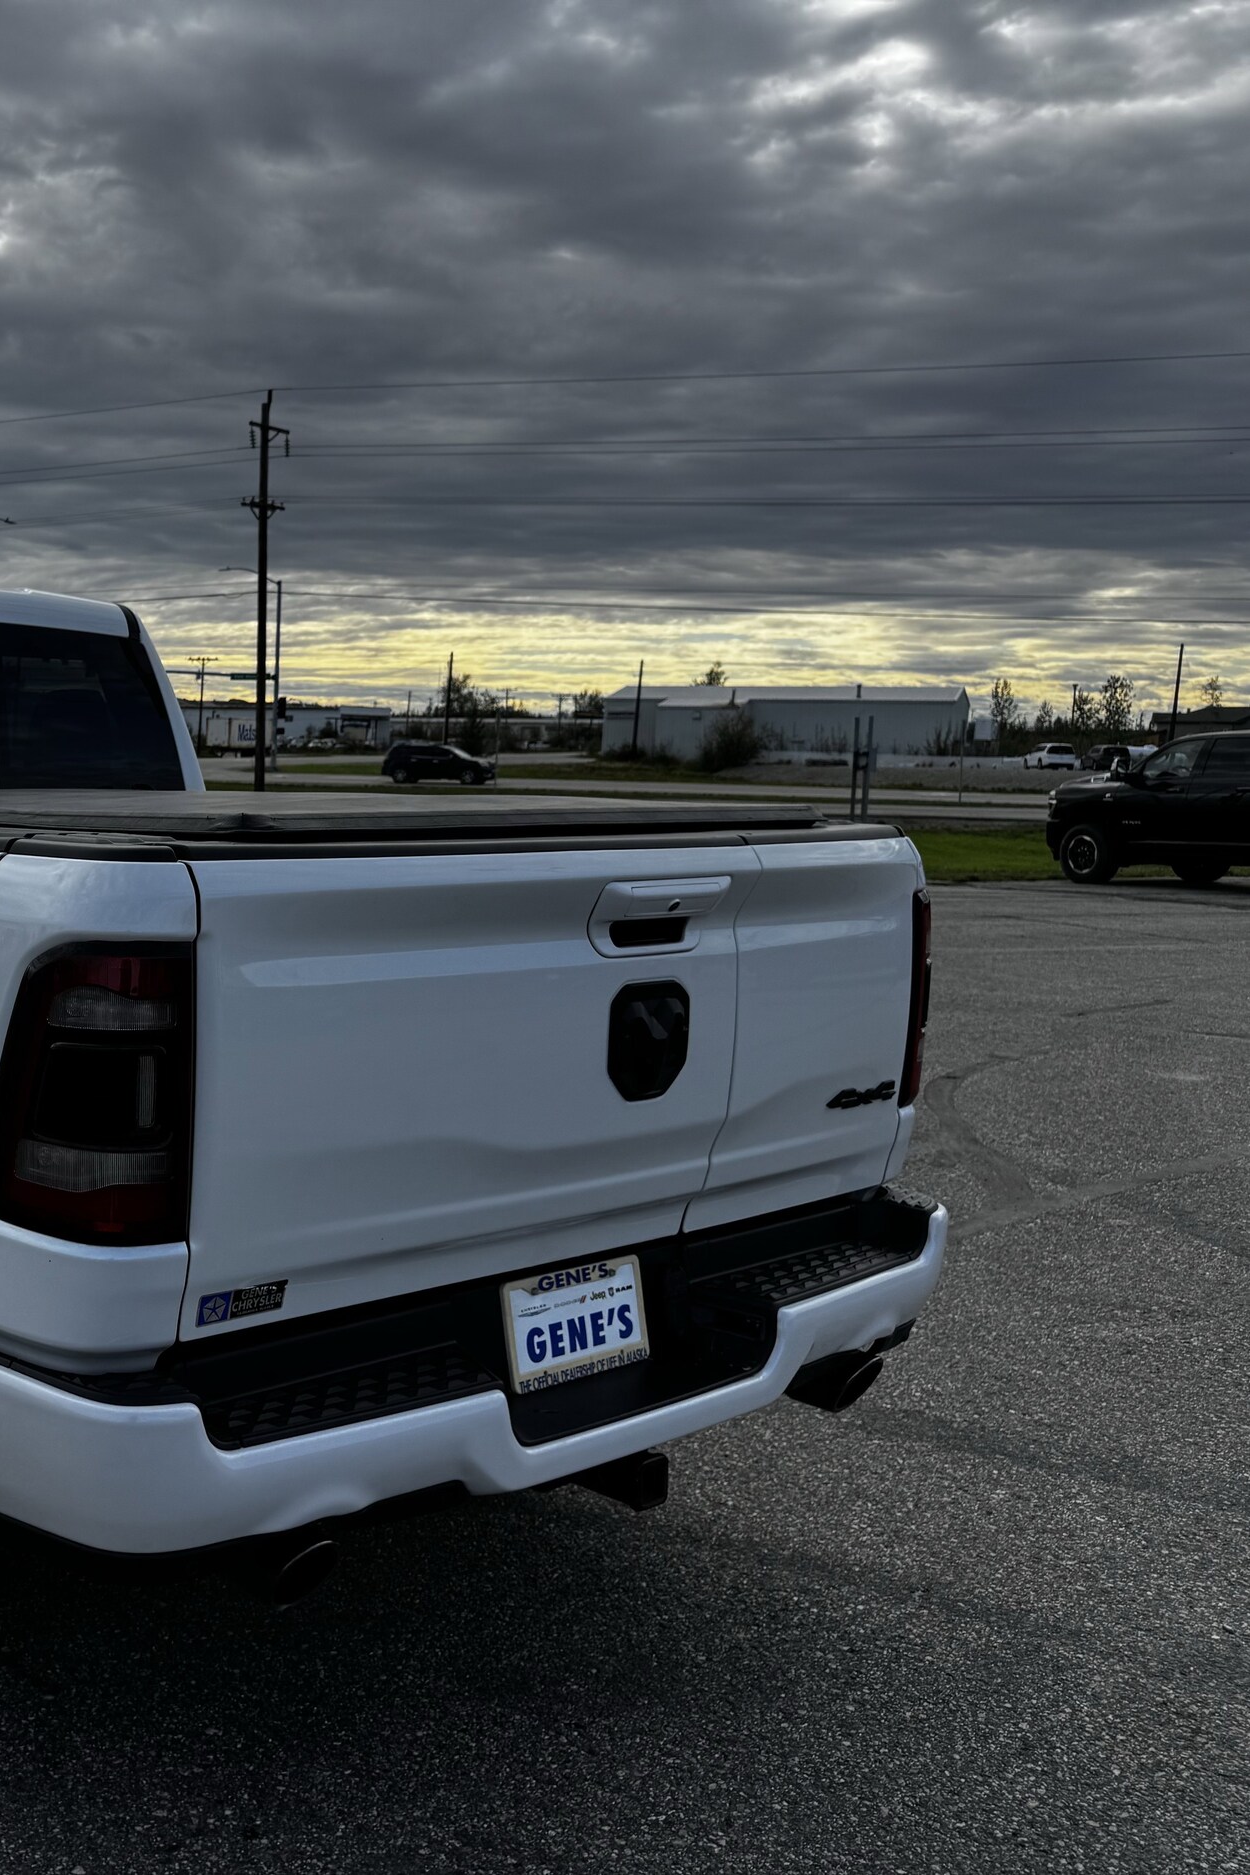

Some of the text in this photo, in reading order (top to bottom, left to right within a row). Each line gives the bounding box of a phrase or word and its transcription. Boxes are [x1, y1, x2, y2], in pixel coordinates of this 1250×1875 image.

[538, 1263, 609, 1292] GENE'S
[231, 1292, 282, 1312] CHRYSLER
[241, 1285, 278, 1300] GENE'S
[590, 1291, 606, 1301] Jeep
[526, 1304, 634, 1364] GENE'S
[519, 1347, 648, 1394] THE OFFICIAL DEALERSHIP OF LIFE IN ALASKA
